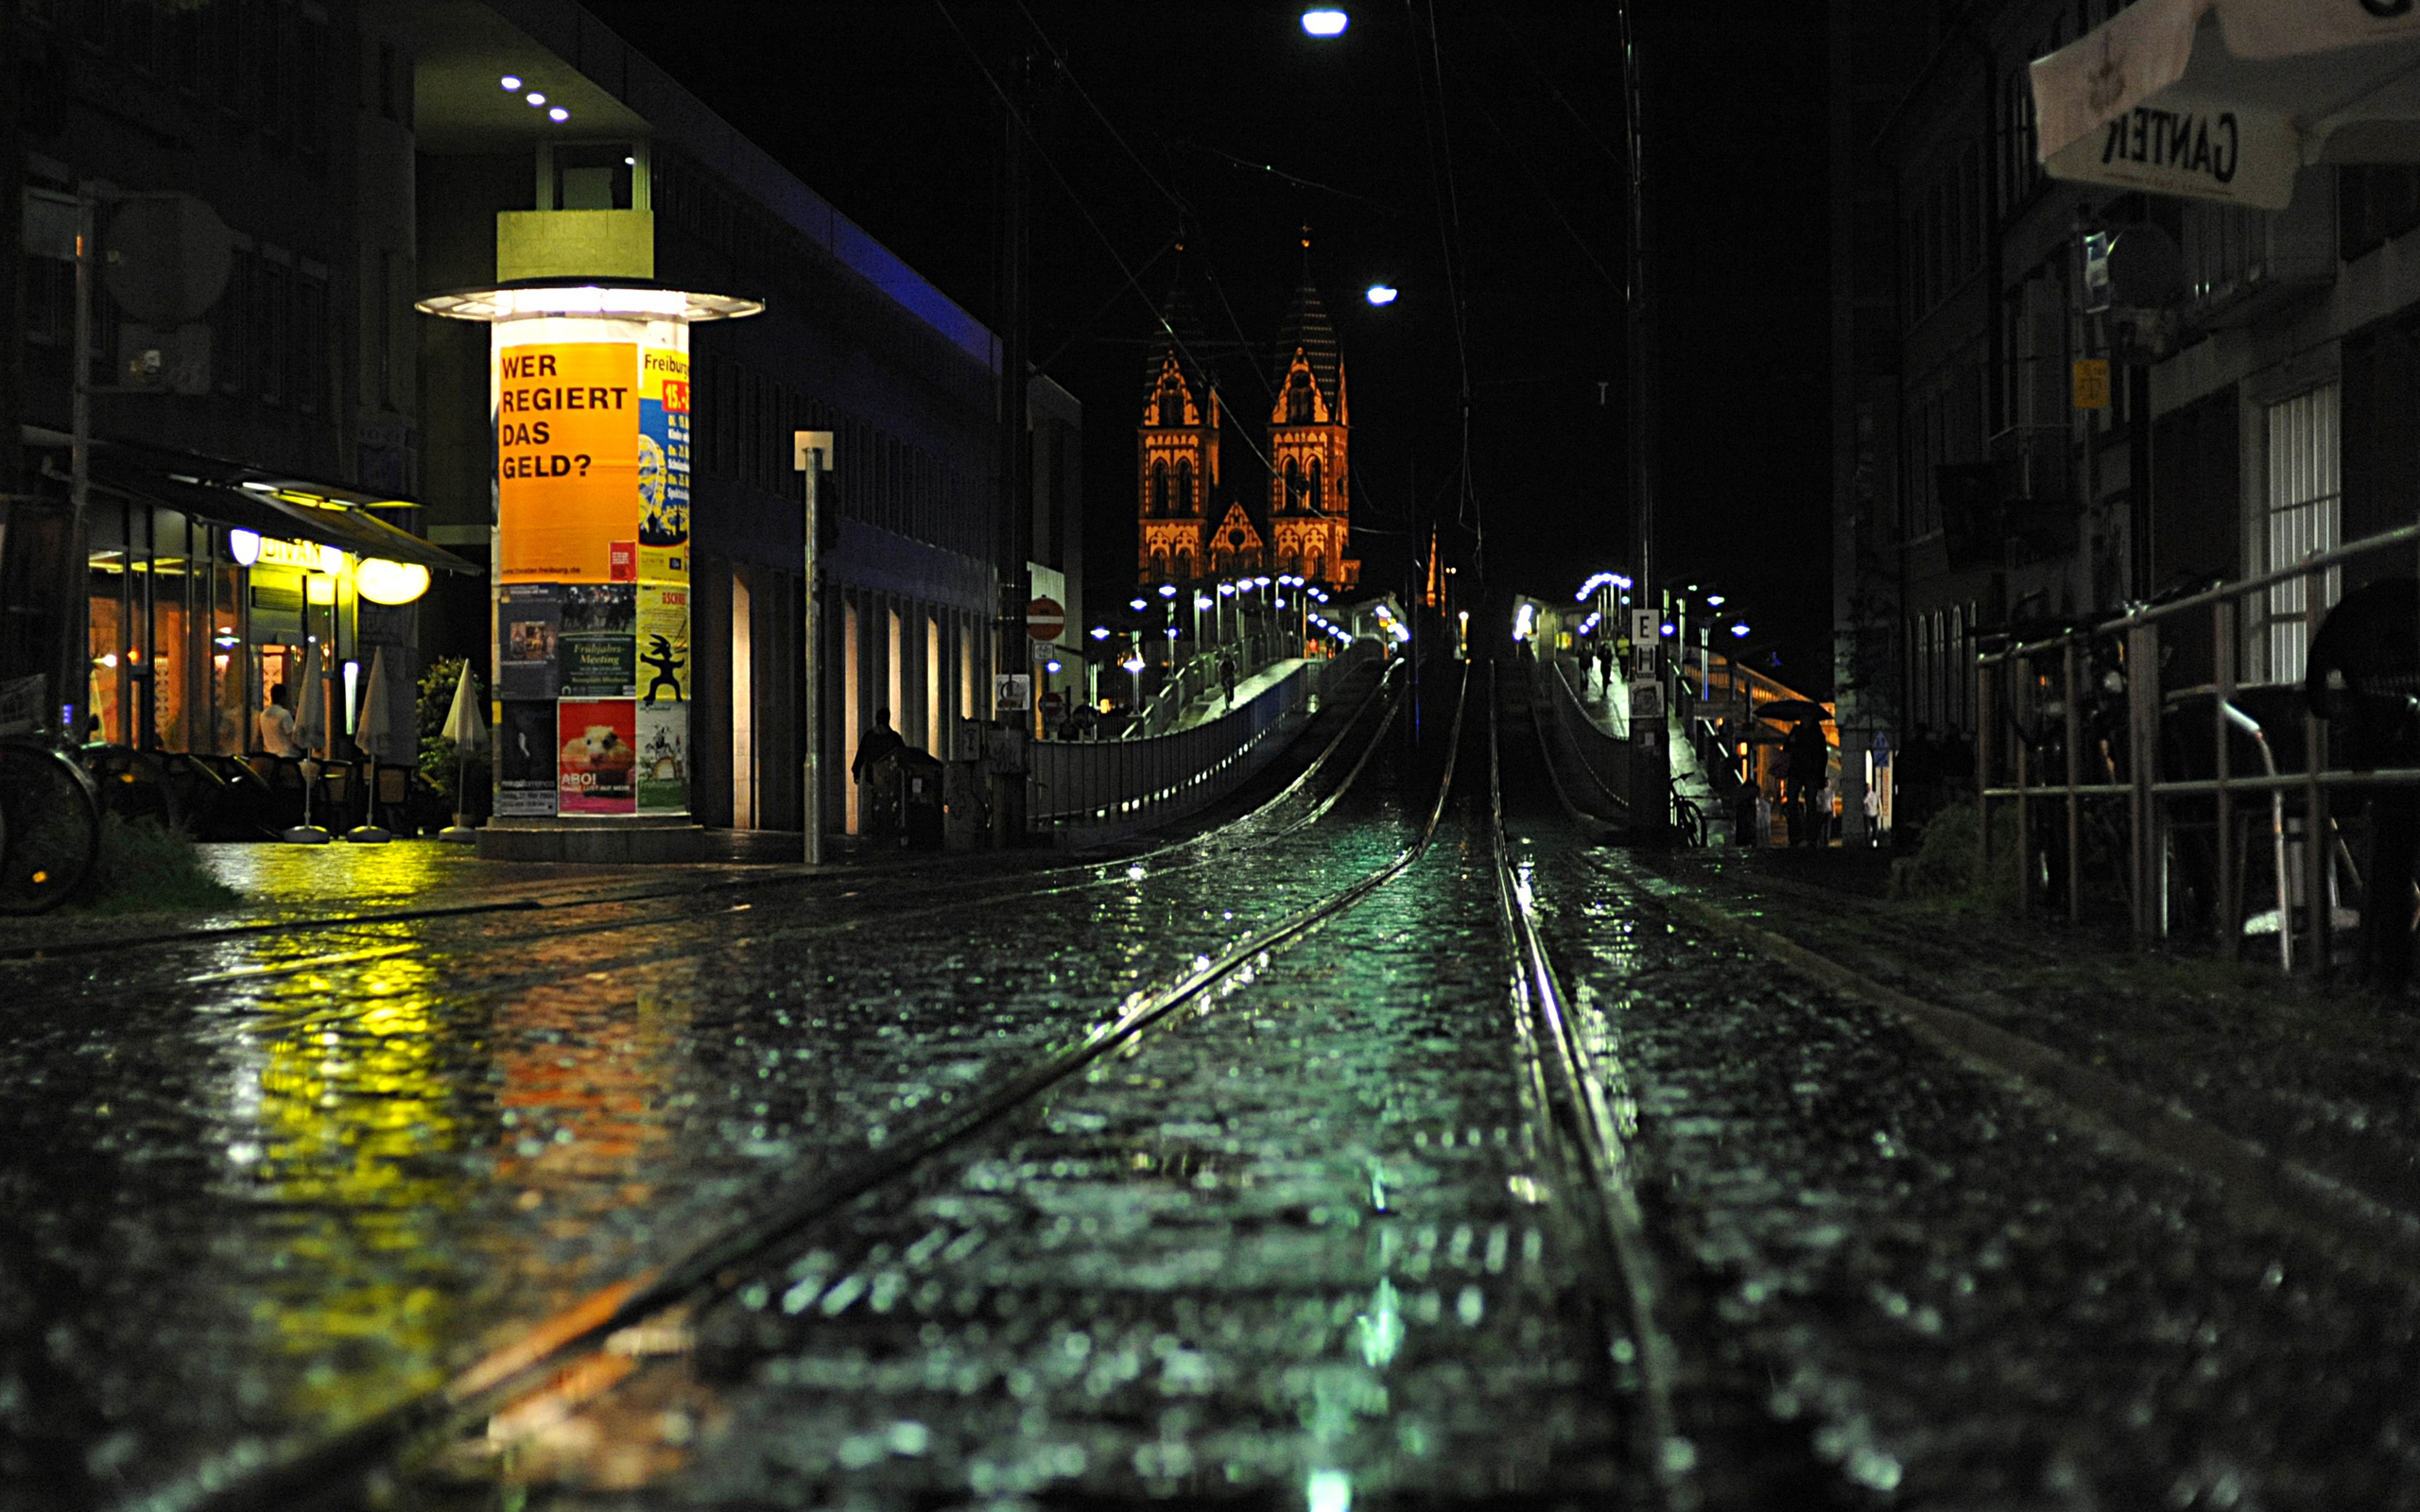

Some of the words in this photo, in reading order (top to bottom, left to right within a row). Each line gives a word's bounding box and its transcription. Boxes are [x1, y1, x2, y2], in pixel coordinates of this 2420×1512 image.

[501, 353, 557, 380] WER
[502, 387, 628, 414] REGIERT
[502, 421, 550, 447] DAS
[502, 454, 592, 479] GELD?
[1640, 615, 1650, 638] E
[579, 654, 620, 666] Meeting
[562, 772, 597, 785] ABO!
